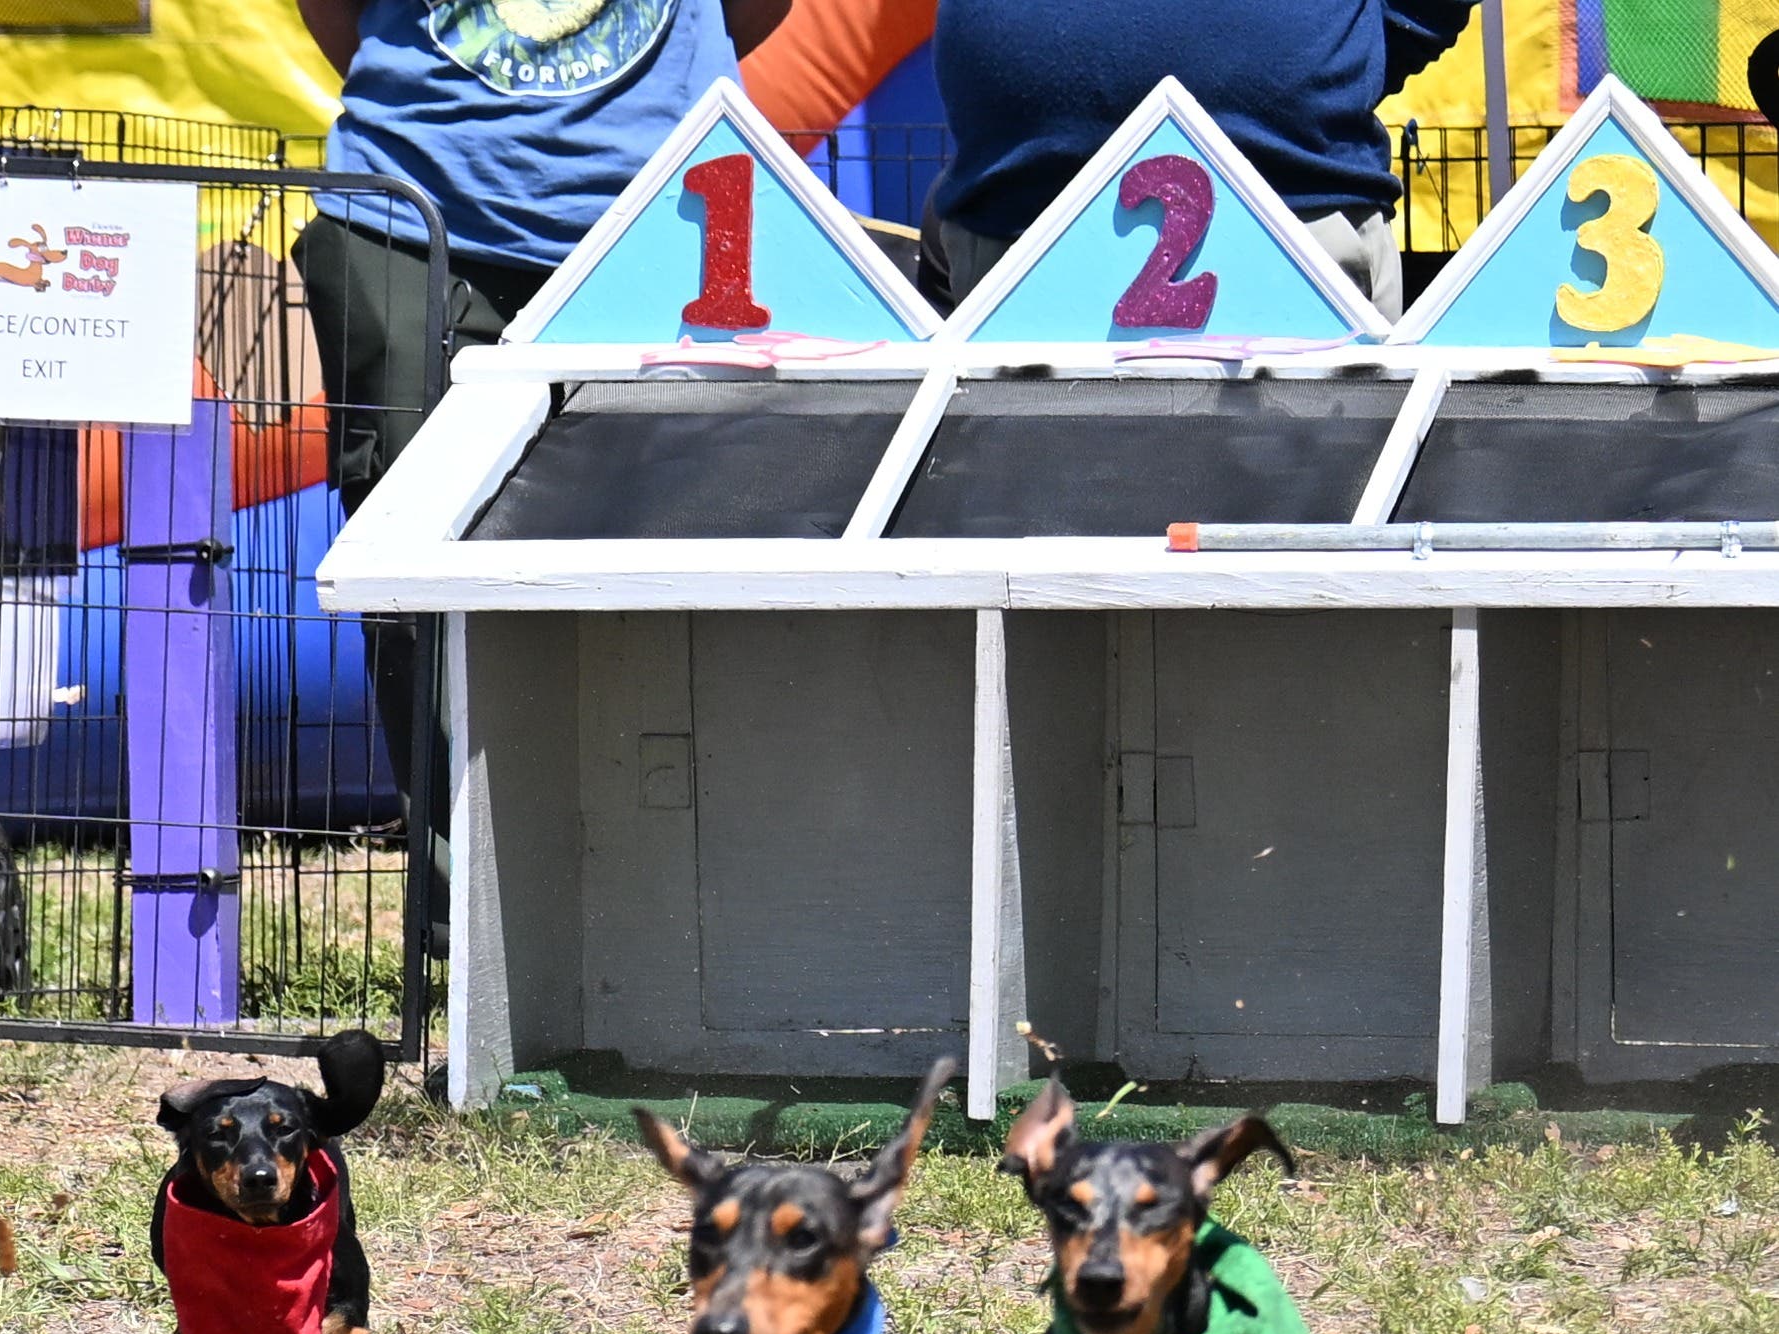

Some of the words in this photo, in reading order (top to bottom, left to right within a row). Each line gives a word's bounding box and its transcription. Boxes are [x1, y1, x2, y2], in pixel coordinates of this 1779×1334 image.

[482, 50, 611, 84] FLORIDA
[681, 153, 771, 330] 1
[1112, 154, 1219, 331] 2
[1555, 154, 1664, 332] 3
[79, 249, 119, 278] Dog
[62, 272, 117, 297] Derby
[22, 359, 67, 379] EXIT
